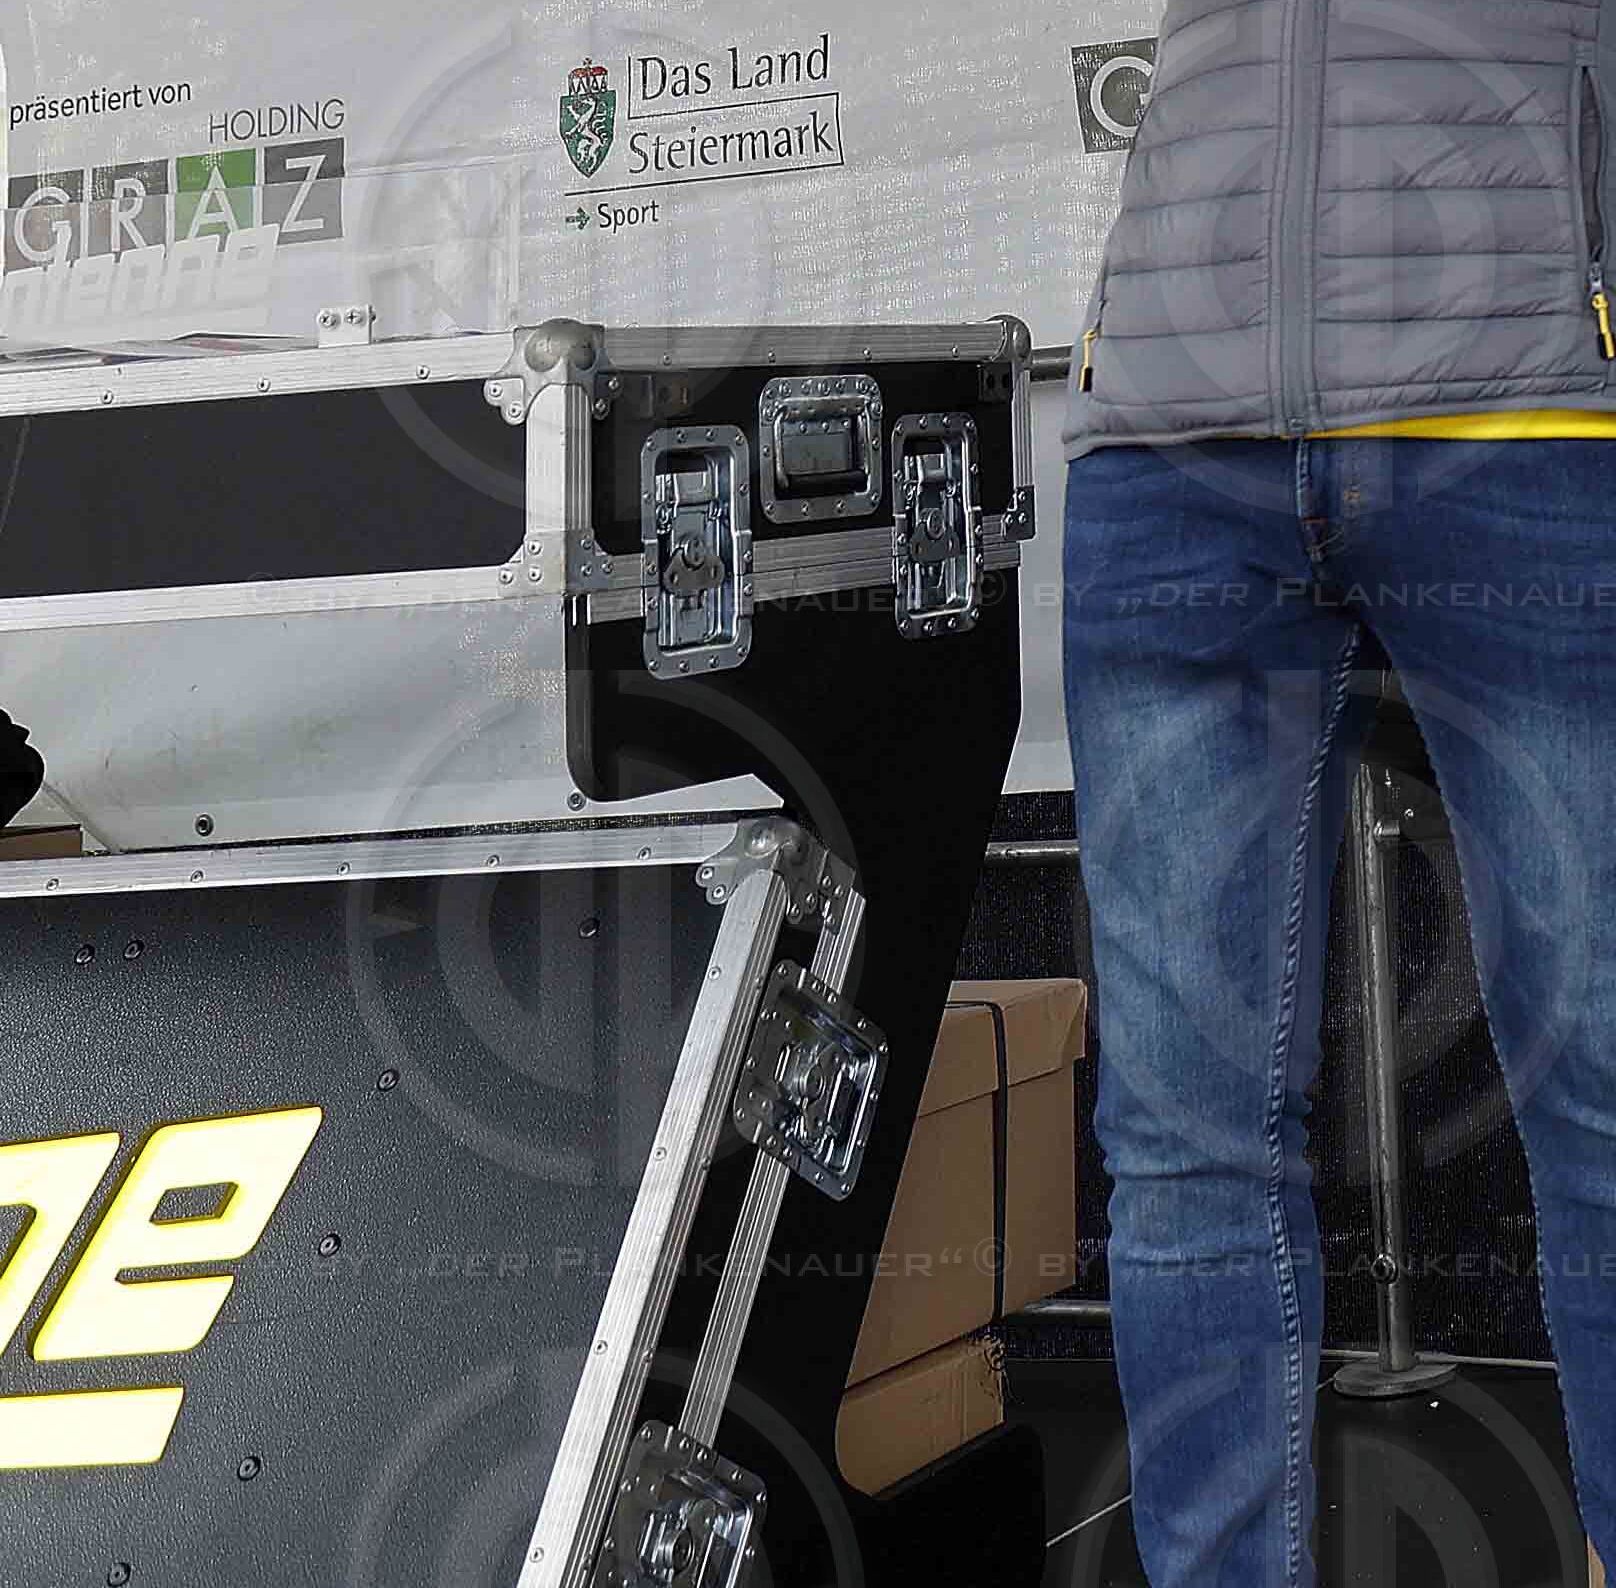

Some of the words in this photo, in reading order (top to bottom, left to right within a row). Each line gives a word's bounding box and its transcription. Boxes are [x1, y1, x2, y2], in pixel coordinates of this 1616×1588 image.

[637, 55, 712, 101] Das
[727, 33, 829, 91] Land
[9, 84, 143, 131] präsentiert
[148, 81, 192, 106] von
[208, 98, 345, 144] HOLDING
[628, 111, 834, 174] Steiermark
[12, 153, 329, 264] GRAZ
[597, 199, 660, 234] Sport
